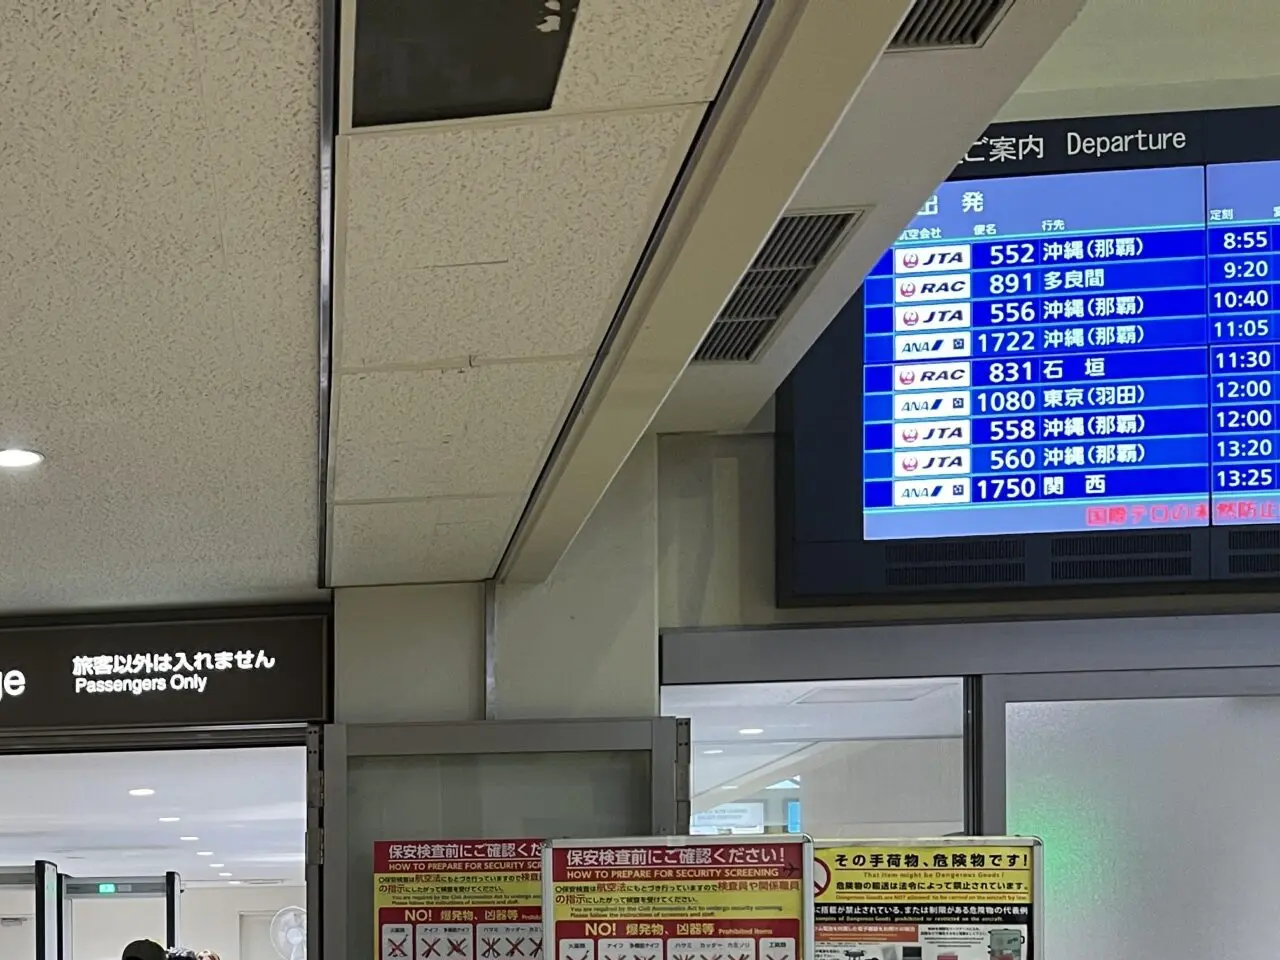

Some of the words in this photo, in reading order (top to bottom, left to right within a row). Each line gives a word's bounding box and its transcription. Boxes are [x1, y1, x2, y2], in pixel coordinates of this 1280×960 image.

[958, 134, 1044, 163] ご案内
[1067, 130, 1186, 160] Departure
[1042, 220, 1065, 231] 行先
[1210, 208, 1234, 220] 定刻
[974, 224, 997, 235] 便名
[922, 252, 964, 265] JTA
[990, 244, 1035, 264] 552
[1043, 237, 1144, 262] 沖縄(那覇)
[1223, 231, 1268, 249] 8:55
[920, 281, 966, 293] RAC
[990, 273, 1033, 292] 891
[1043, 269, 1105, 291] 多良間
[1224, 260, 1268, 278] 9:20
[922, 310, 964, 323] JTA
[990, 302, 1035, 321] 556
[1043, 296, 1144, 320] 沖縄(那覇)
[1214, 290, 1269, 308] 10:40
[977, 331, 1035, 352] 1722
[1043, 325, 1144, 349] 沖縄(那覇)
[1214, 319, 1269, 337] 11:05
[920, 369, 965, 382] RAC
[990, 361, 1033, 381] 831
[1216, 351, 1271, 369] 11:30
[977, 390, 1035, 411] 1080
[1043, 385, 1145, 407] 東京(羽田)
[1216, 381, 1272, 399] 12:00
[922, 427, 963, 440] JTA
[990, 419, 1036, 440] 558
[1043, 413, 1145, 437] 沖縄(那覇)
[1216, 410, 1272, 428] 12:00
[922, 456, 963, 469] JTA
[990, 449, 1036, 470] 560
[1043, 442, 1145, 466] 沖縄(那覇)
[1217, 439, 1272, 458] 13:20
[977, 478, 1036, 500] 1750
[1217, 469, 1273, 487] 13:25
[72, 650, 275, 676] 旅客以外は入れません
[75, 677, 167, 696] Passengers
[170, 673, 208, 693] Only
[389, 862, 411, 871] HOW
[412, 862, 426, 870] TO
[428, 862, 463, 870] PREPARE
[465, 861, 482, 870] FOR
[483, 861, 526, 870] SECURITY
[566, 847, 785, 867] 保安検査前にご確認ください!
[835, 853, 1028, 868] その手荷物、危険物です!
[567, 870, 593, 880] HOW
[595, 870, 608, 879] TO
[611, 869, 652, 879] PREPARE
[654, 868, 673, 878] FOR
[675, 868, 720, 878] SECURITY
[724, 867, 779, 877] SCREENING
[404, 909, 432, 922] NO!
[584, 922, 617, 936] NO!
